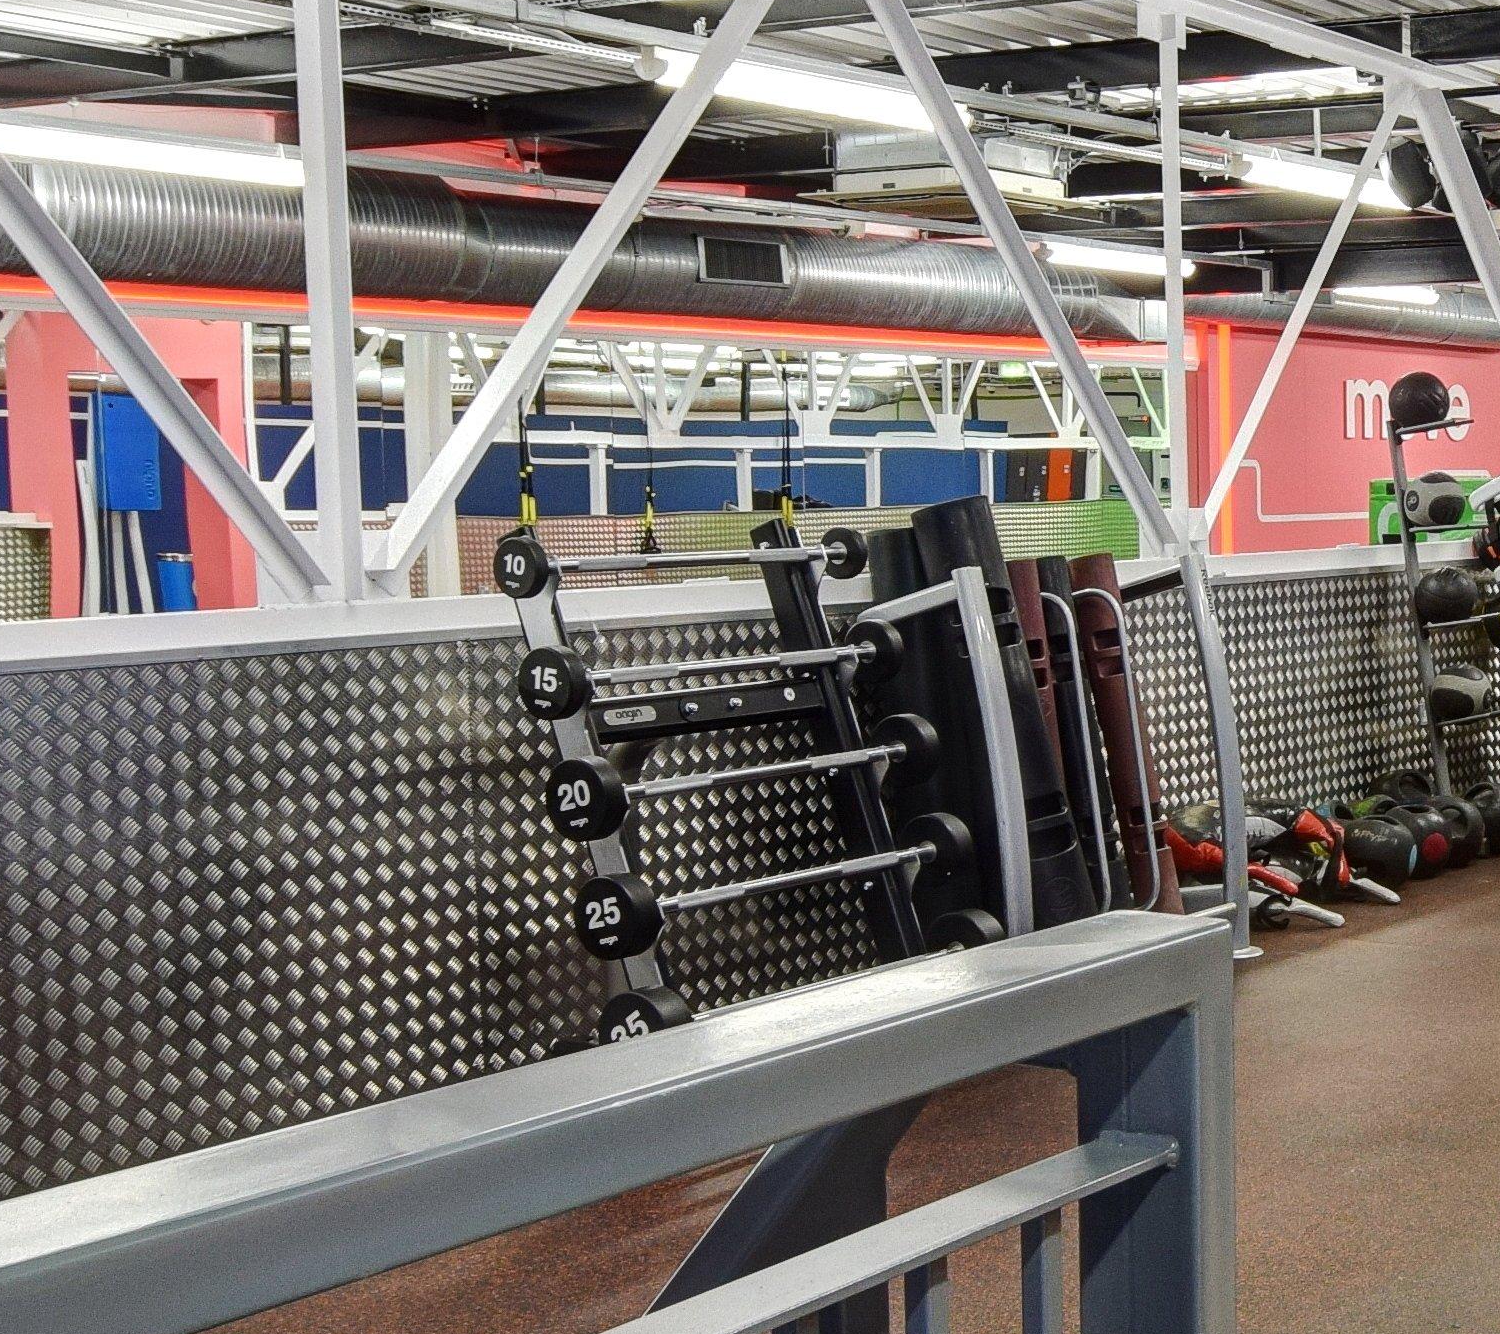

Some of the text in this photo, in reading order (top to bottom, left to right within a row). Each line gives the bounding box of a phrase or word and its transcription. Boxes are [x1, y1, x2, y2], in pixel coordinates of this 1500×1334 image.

[1343, 378, 1470, 441] me
[503, 553, 526, 576] 10
[531, 666, 558, 693] 15
[557, 779, 591, 812] 20
[585, 896, 621, 930] 25
